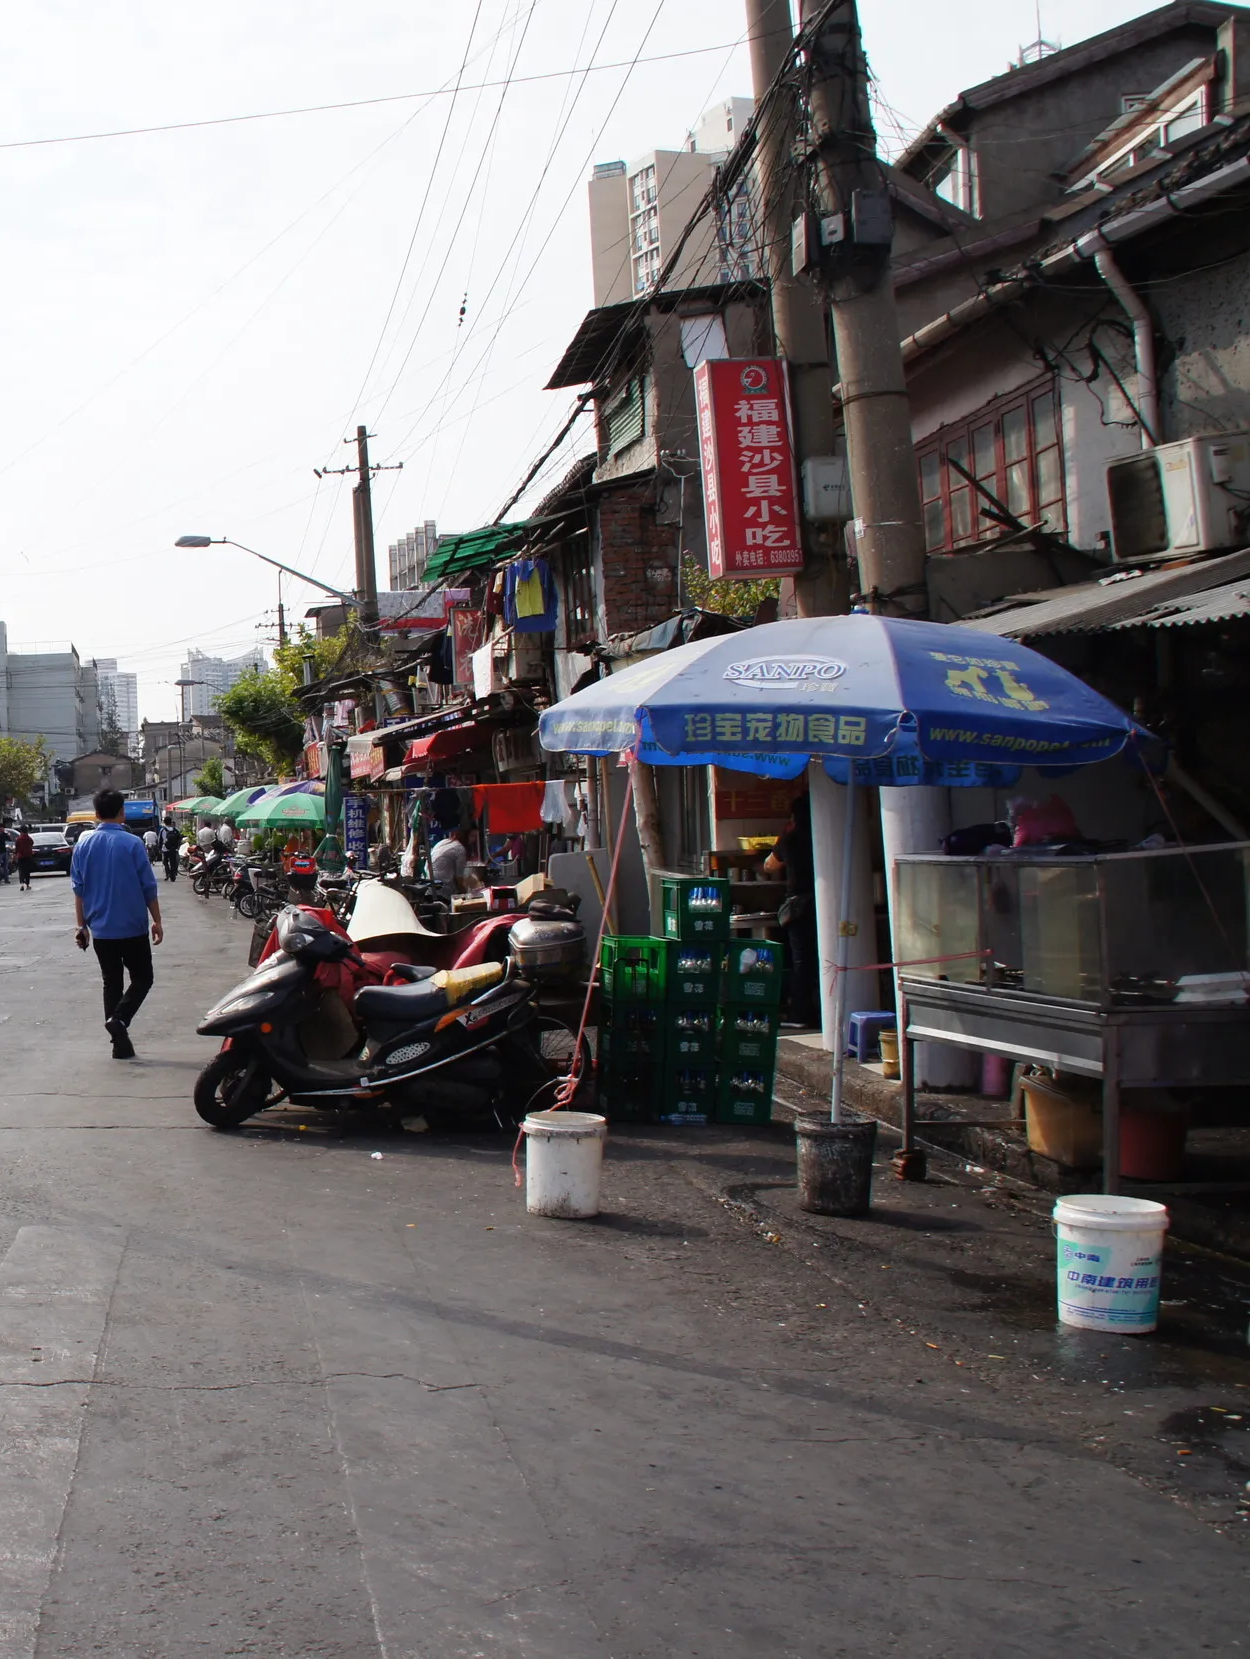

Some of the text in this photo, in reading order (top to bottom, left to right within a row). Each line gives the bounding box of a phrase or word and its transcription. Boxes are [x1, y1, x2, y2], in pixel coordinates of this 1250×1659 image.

[699, 376, 721, 566] 福建沙县小吃
[734, 399, 790, 547] 福建沙县小吃
[722, 661, 848, 680] SANPO
[684, 712, 867, 746] 珍宝宠物食品
[929, 727, 1111, 754] www.sanpopet.m
[723, 788, 790, 812] 十三香
[694, 919, 714, 931] 雪花
